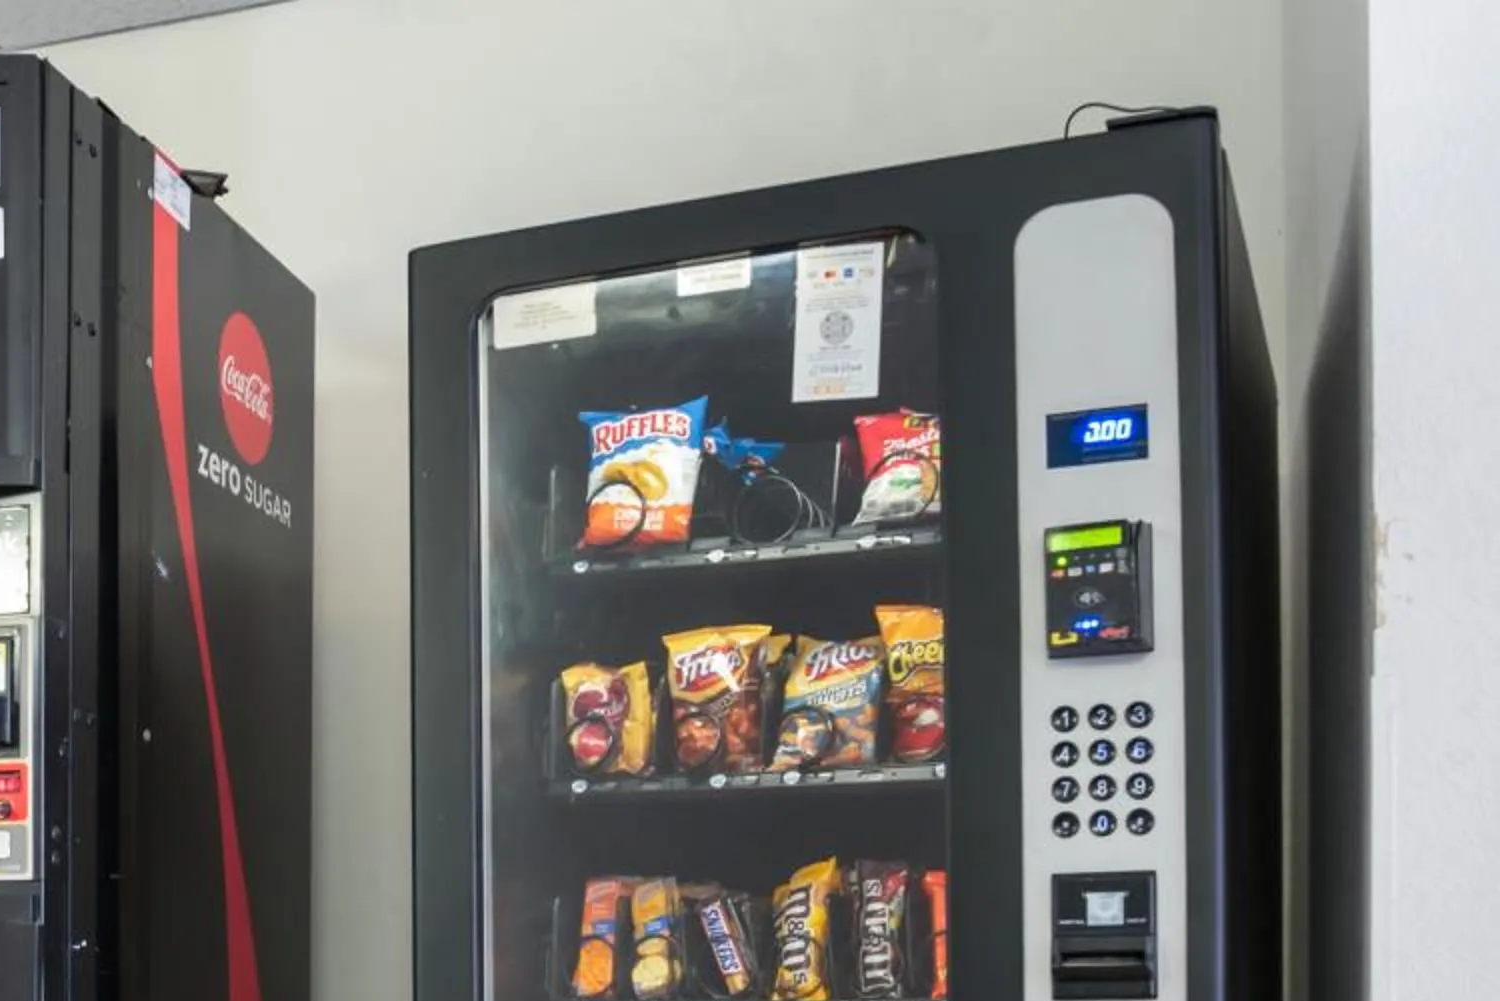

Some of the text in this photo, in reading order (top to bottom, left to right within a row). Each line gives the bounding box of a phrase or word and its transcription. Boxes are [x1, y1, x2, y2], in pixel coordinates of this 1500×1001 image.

[594, 412, 690, 453] RUFFLES
[198, 444, 291, 528] zero SUGAR
[1061, 705, 1146, 728] 1 2 3
[1059, 742, 1146, 762] 4 5 6
[1061, 777, 1147, 798] 7 8 9
[1096, 815, 1109, 833] 0
